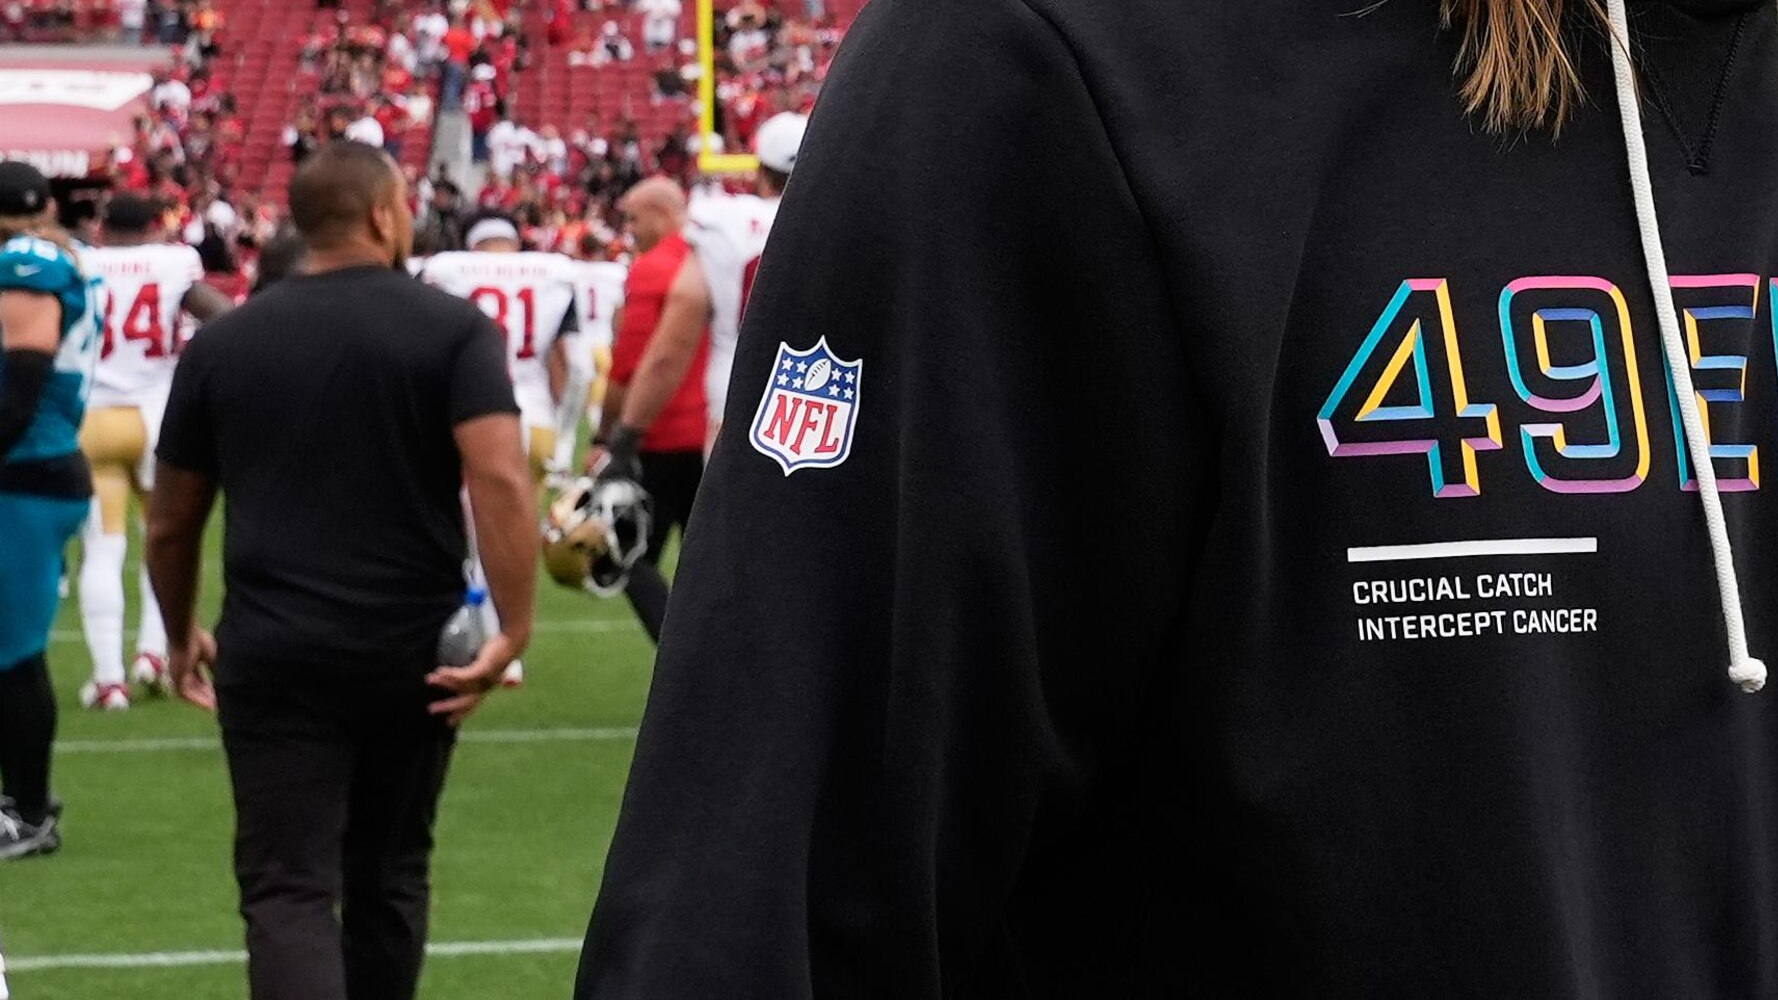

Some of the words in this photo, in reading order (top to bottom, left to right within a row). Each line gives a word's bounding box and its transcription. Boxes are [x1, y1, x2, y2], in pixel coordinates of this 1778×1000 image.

[763, 394, 840, 455] NFL
[1352, 576, 1471, 605] CRUCIAL
[1476, 573, 1552, 599] CATCH
[1357, 610, 1507, 641] INTERCEPT
[1512, 608, 1598, 634] CANCER
